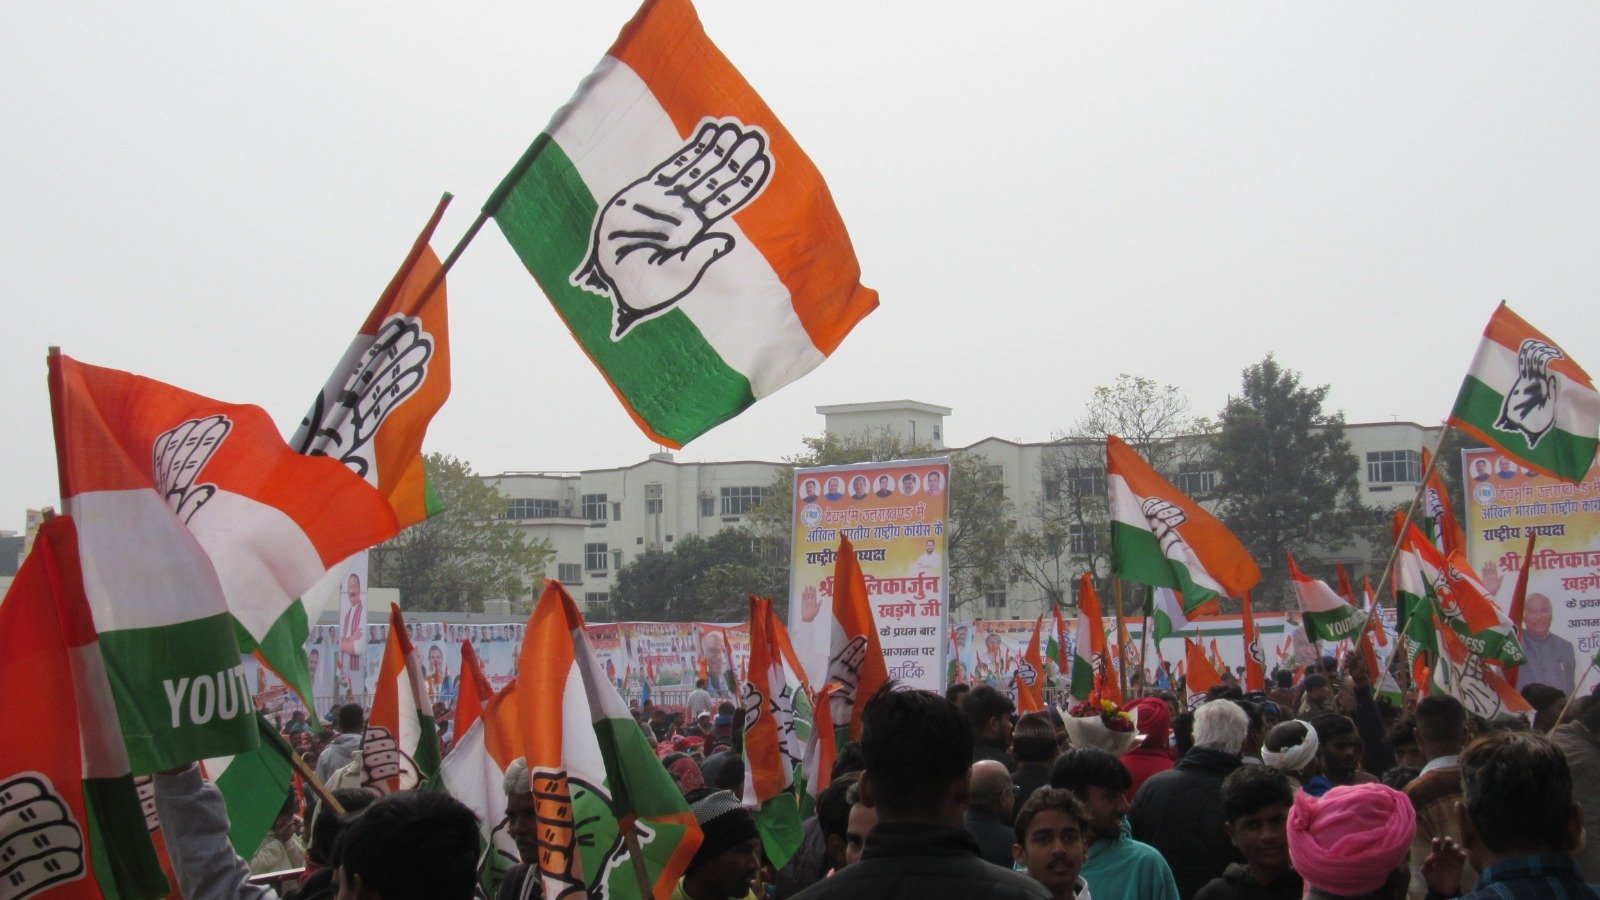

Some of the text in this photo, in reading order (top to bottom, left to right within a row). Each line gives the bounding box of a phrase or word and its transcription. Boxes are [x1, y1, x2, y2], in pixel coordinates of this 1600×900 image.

[824, 506, 859, 526] देवभूमि
[862, 506, 913, 522] उत्तराखण्ड
[916, 503, 926, 519] में
[1516, 501, 1547, 516] भारतीय
[1550, 499, 1579, 517] राष्ट्रीय
[806, 526, 835, 542] अखिल
[874, 522, 900, 541] राष्ट्रीय
[903, 519, 932, 537] कांग्रेस
[934, 520, 944, 535] के
[1482, 525, 1520, 542] राष्ट्रीय
[853, 548, 887, 562] ध्यक्ष
[1498, 551, 1521, 572] श्री
[864, 572, 940, 599] लिकार्जुन
[878, 598, 941, 621] खड़गे जी
[880, 626, 936, 637] के प्रथम बार
[882, 646, 936, 657] आगमन पर
[1502, 640, 1523, 661] ESS
[162, 664, 256, 729] YOUT
